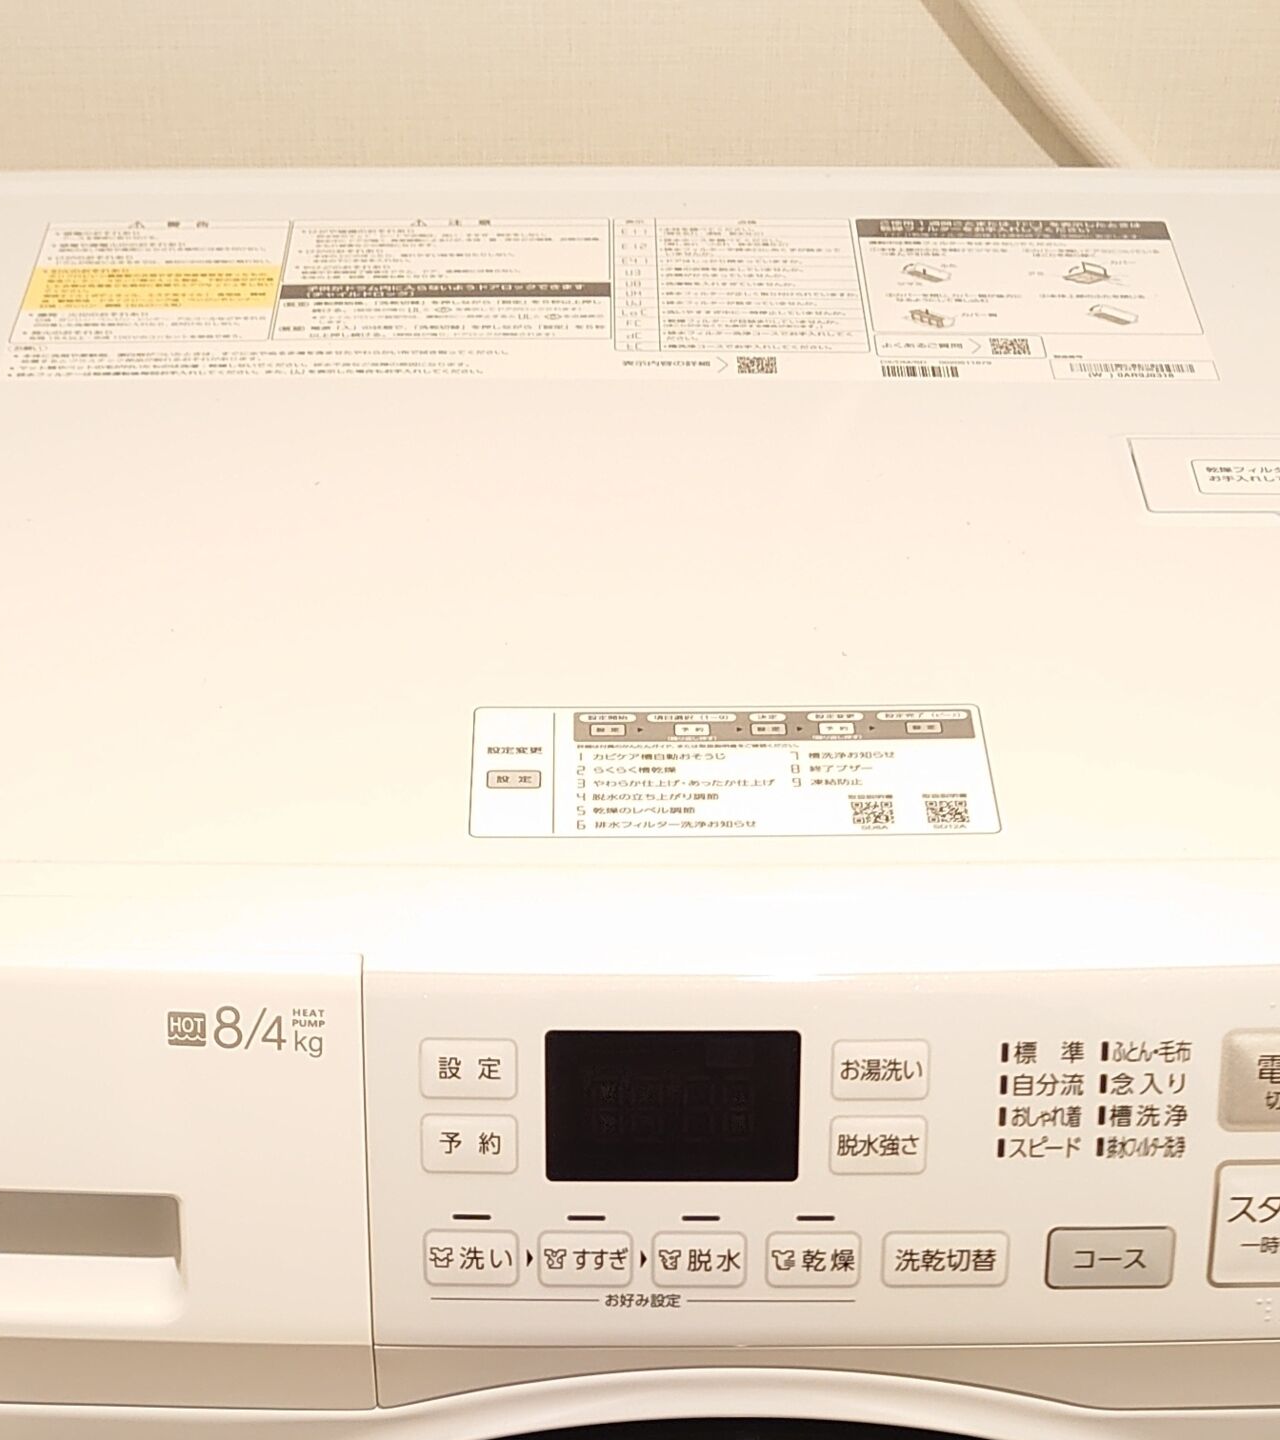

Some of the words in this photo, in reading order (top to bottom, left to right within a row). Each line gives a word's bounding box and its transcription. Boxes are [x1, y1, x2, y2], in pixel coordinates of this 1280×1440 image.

[486, 746, 543, 755] 設定変更
[579, 752, 584, 761] 1
[592, 751, 726, 761] カビケア槽自動おそうじ
[790, 751, 800, 761] 7
[808, 751, 895, 759] 槽洗浄お知らせ
[576, 766, 586, 775] 2
[592, 765, 677, 774] らくらく槽乾燥
[791, 764, 801, 774] 8
[809, 763, 873, 773] 終了ブザー
[496, 775, 533, 784] 設定
[577, 779, 586, 789] 3
[792, 777, 802, 787] 9
[809, 777, 863, 786] 凍結防止
[576, 793, 586, 802] 4
[592, 791, 720, 801] 脱水の立ち上がり調節
[576, 806, 586, 816] 5
[592, 805, 696, 815] 乾燥のレベル調節
[576, 820, 586, 830] 6
[593, 818, 757, 829] 排水フィルター洗浄お知らせ
[292, 1008, 325, 1017] HEAT
[168, 1016, 206, 1034] HOT
[291, 1019, 326, 1028] PUMP
[294, 1030, 324, 1058] kg
[1112, 1041, 1193, 1064] ふとん・毛布
[839, 1059, 923, 1082] お湯洗い
[1013, 1073, 1085, 1097] 自分流
[1110, 1072, 1187, 1096] 念入り
[1010, 1106, 1082, 1128] おしゃれ着
[1109, 1104, 1188, 1127] 槽洗浄
[836, 1133, 920, 1157] 脱水強さ
[1009, 1136, 1081, 1159] スピード
[459, 1247, 513, 1273] 洗い
[573, 1247, 629, 1272] すすぎ
[687, 1247, 742, 1273] 脱水
[801, 1247, 857, 1274] 乾燥
[893, 1247, 998, 1274] 洗乾切替
[1072, 1249, 1147, 1271] コース
[604, 1293, 682, 1309] お好み設定
